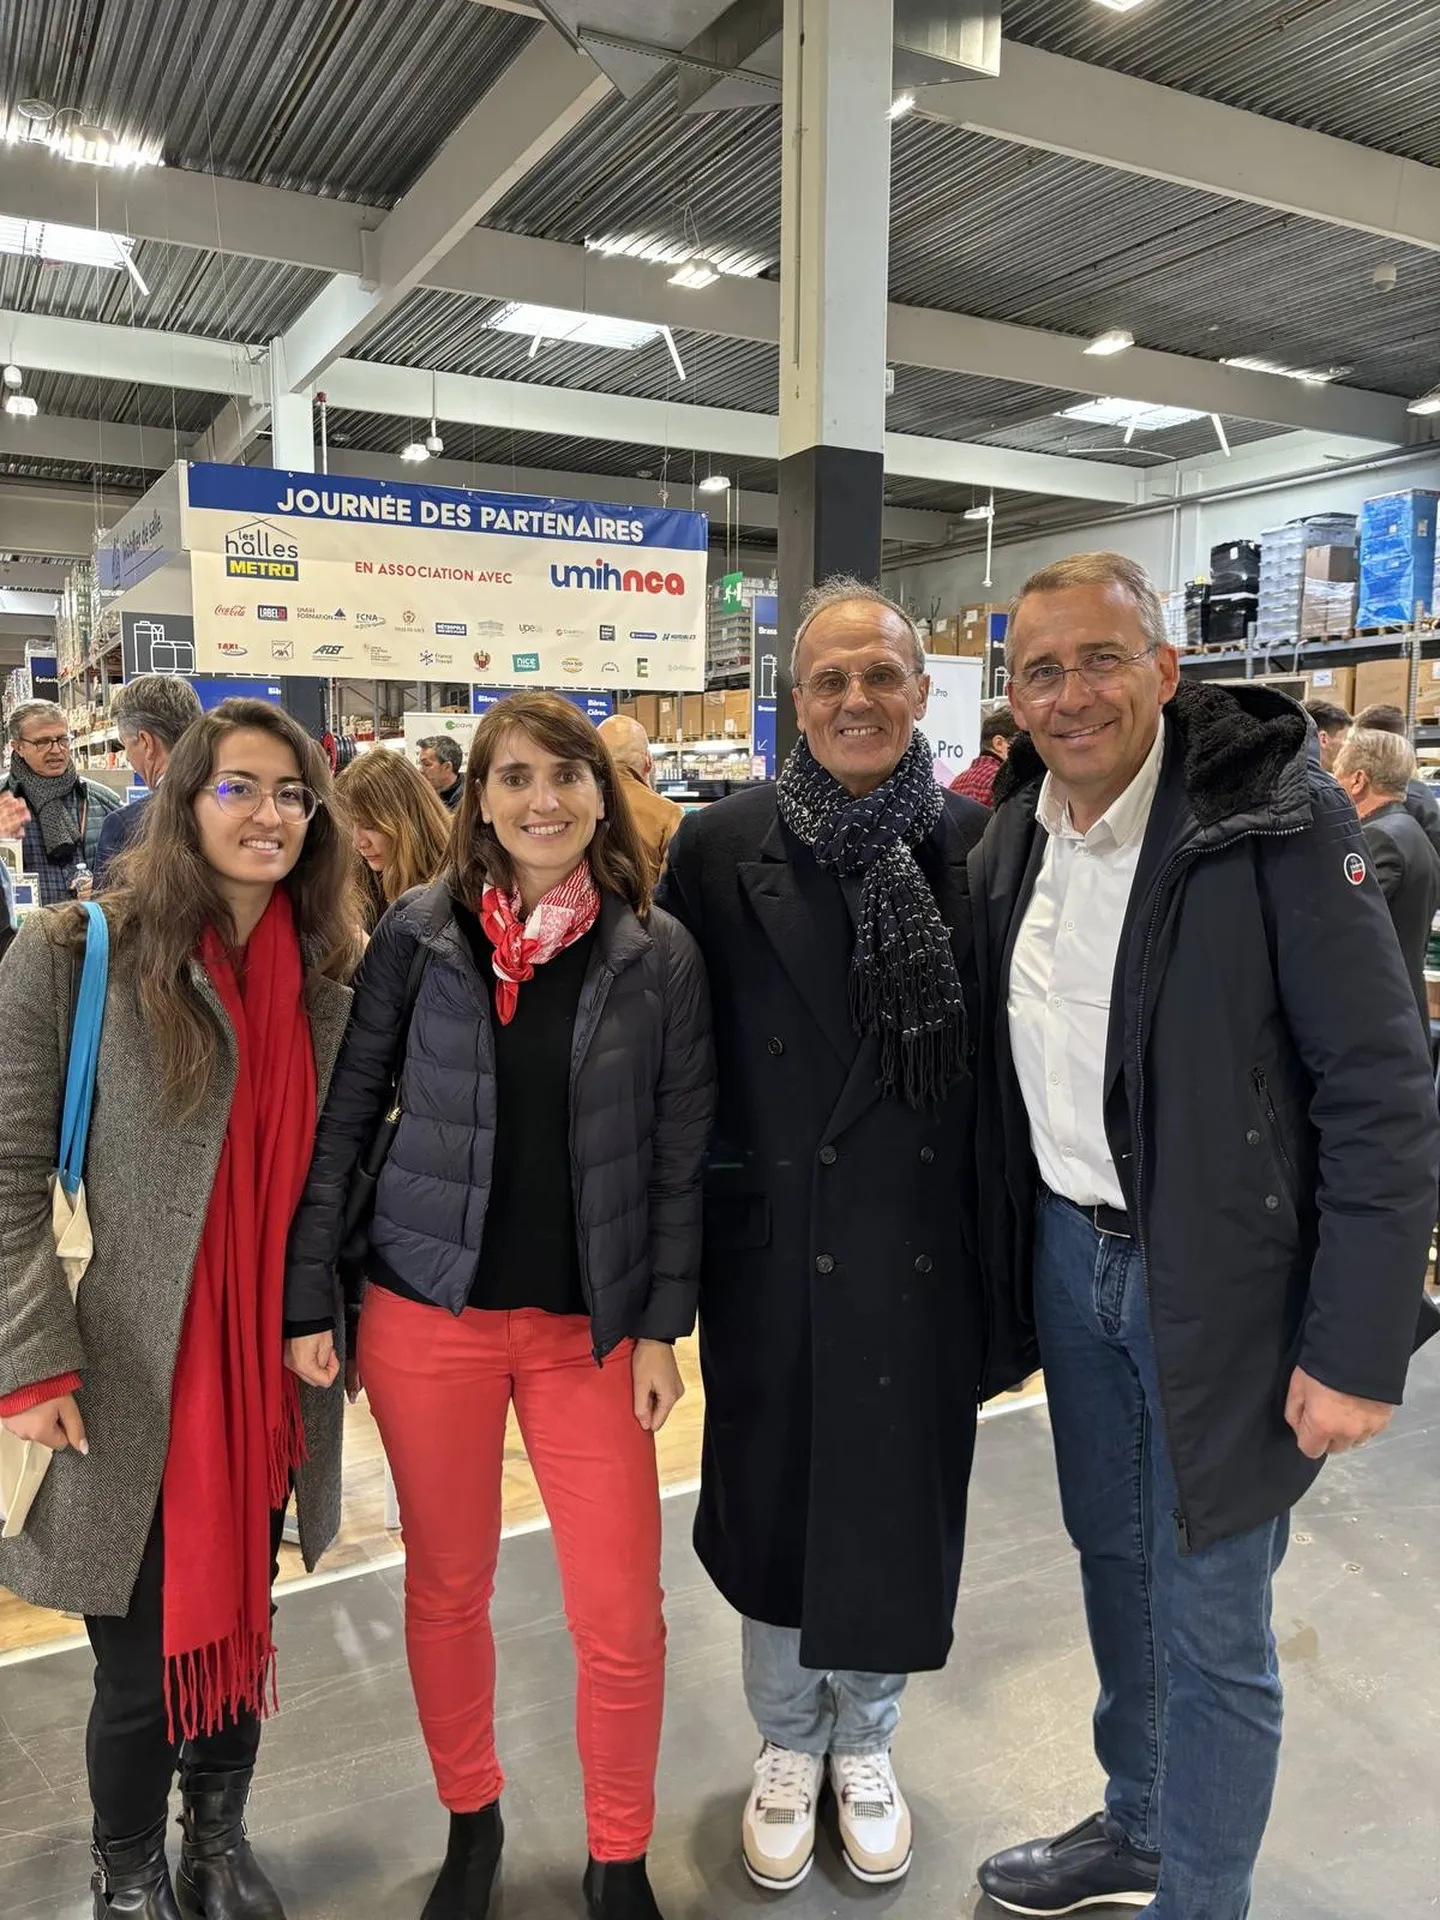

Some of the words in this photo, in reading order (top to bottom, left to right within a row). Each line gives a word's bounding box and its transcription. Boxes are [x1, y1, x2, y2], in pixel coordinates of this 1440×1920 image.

[277, 487, 412, 523] JOURNÉE
[420, 500, 470, 528] DES
[480, 506, 644, 543] PARTENAIRES
[238, 530, 255, 541] les
[225, 529, 298, 559] halles
[229, 560, 295, 578] METRO
[355, 561, 373, 574] EN
[377, 563, 474, 581] ASSOCIATION
[478, 571, 513, 585] AVEC
[550, 558, 685, 596] umihnca
[297, 612, 333, 620] FORMATION
[356, 612, 378, 622] FCNA
[217, 642, 239, 651] TAXI
[516, 656, 536, 667] nice
